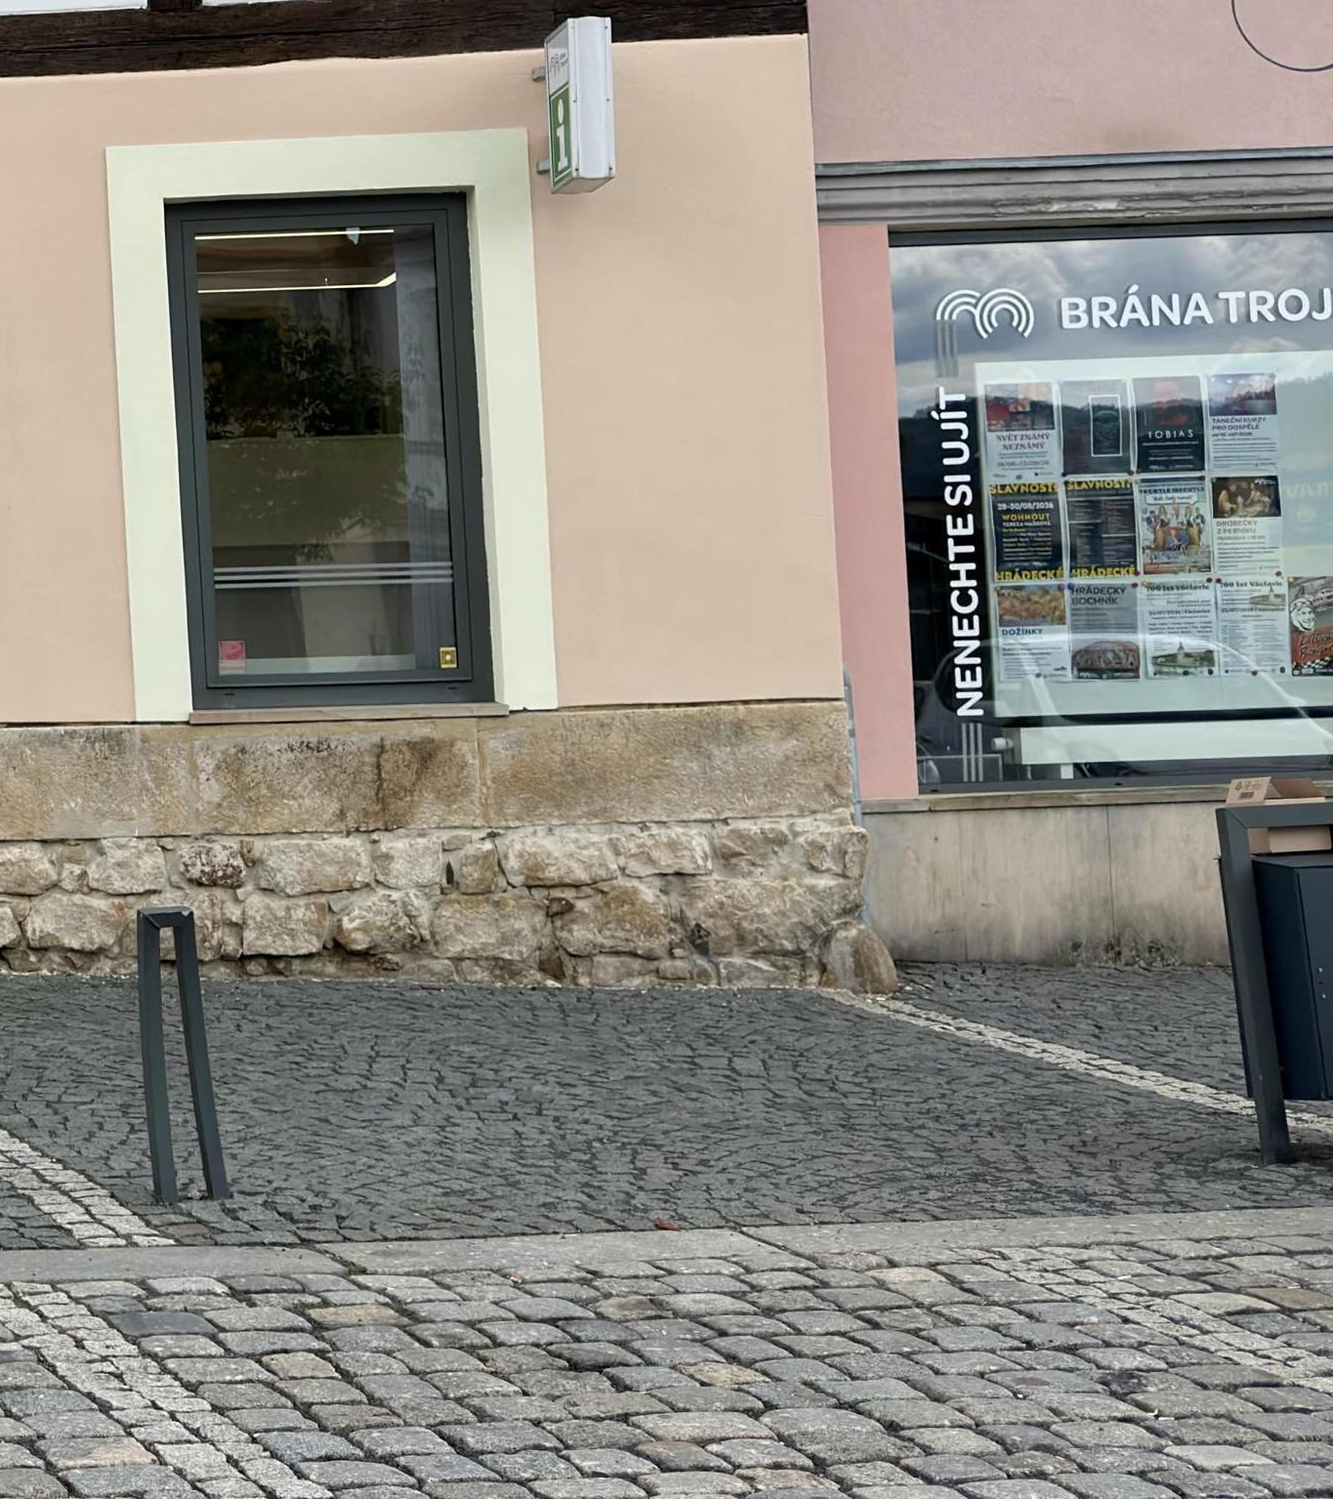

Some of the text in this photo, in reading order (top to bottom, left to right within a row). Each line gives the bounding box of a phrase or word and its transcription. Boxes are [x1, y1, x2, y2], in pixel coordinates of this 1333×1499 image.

[1061, 283, 1333, 329] BRÁNA TROJ
[931, 386, 985, 717] NENECHTE SI UJÍT
